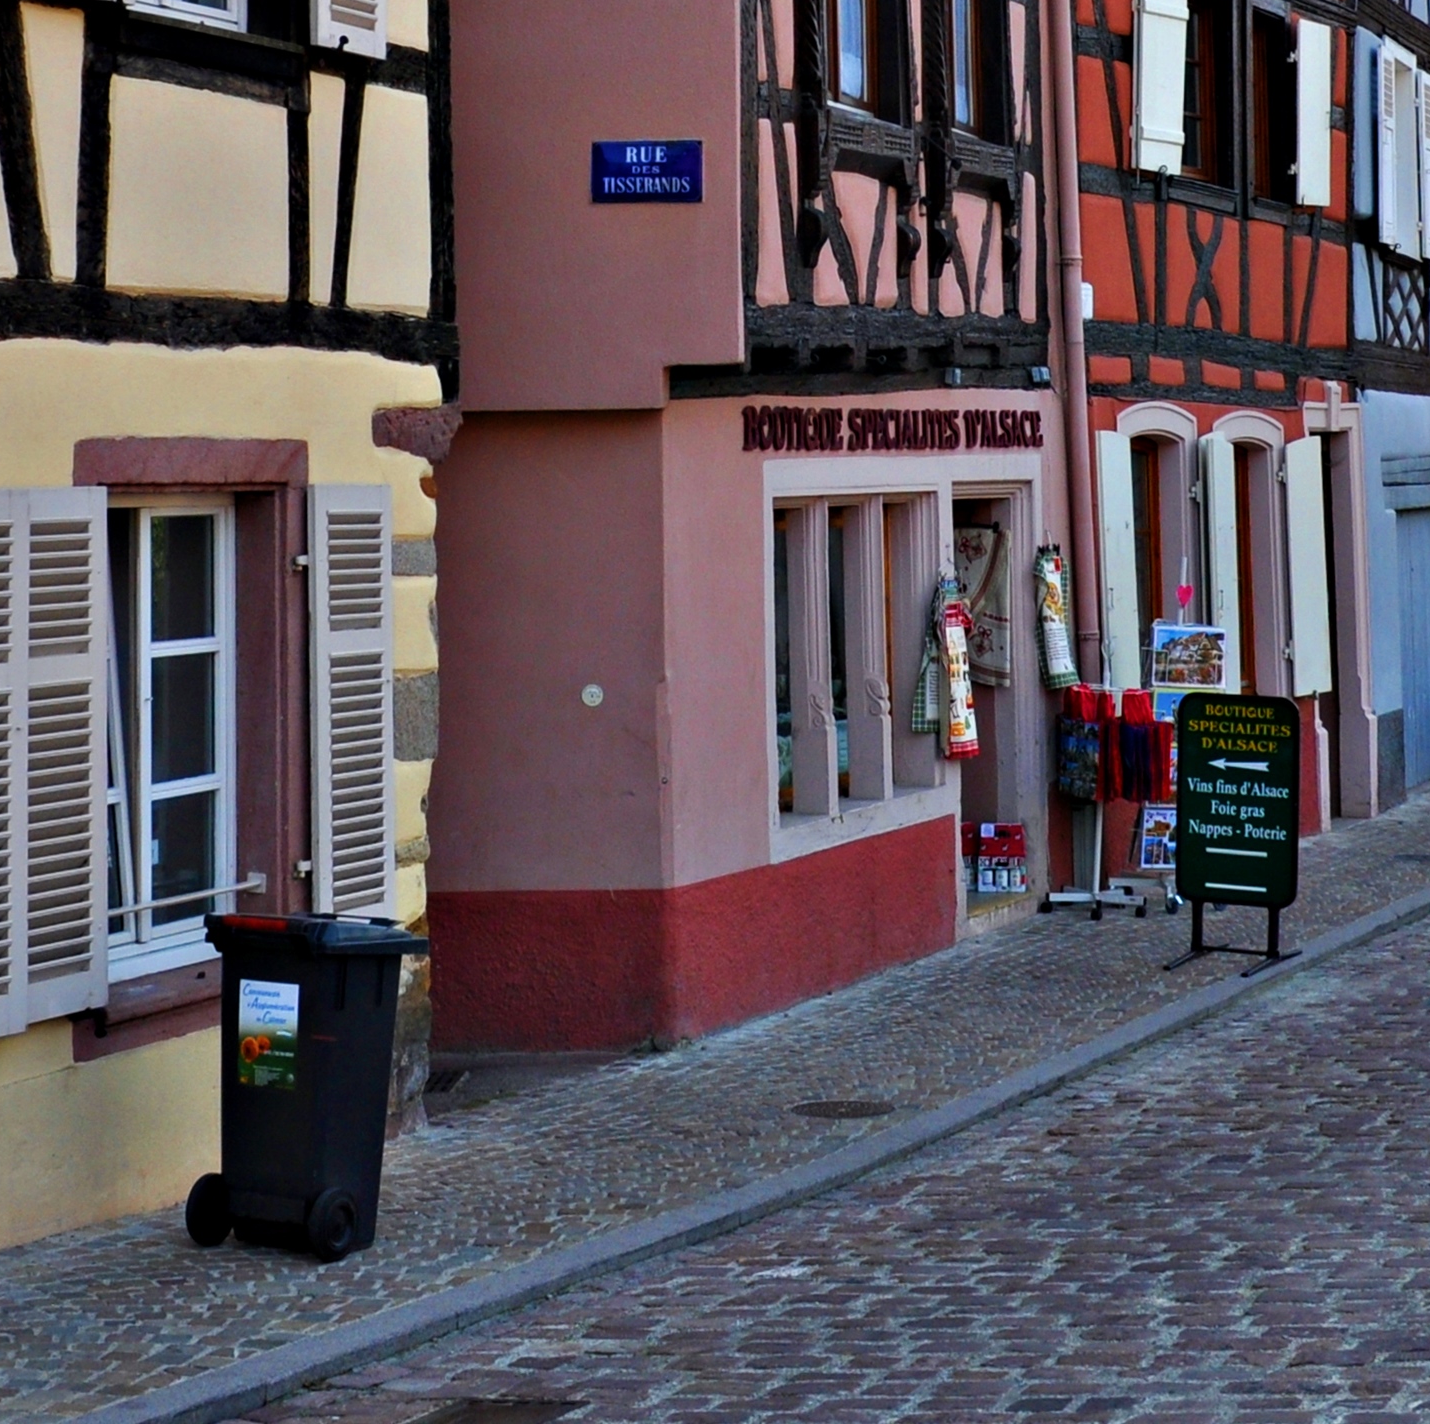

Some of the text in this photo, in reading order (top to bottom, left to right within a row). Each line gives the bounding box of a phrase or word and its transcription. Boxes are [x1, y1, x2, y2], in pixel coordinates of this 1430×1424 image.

[625, 146, 667, 163] RUE
[632, 165, 661, 174] DES
[603, 177, 691, 193] TISSERANDS
[742, 405, 844, 451] BOUTIQUE
[963, 408, 1044, 449] D'ALSACE
[1205, 704, 1275, 720] BOUTIQUE
[1188, 719, 1291, 737] SPECIALITES
[1201, 737, 1278, 754] D'ALSACE
[1187, 777, 1289, 799] Vins fins d'Alsace
[1210, 800, 1265, 821] Foie gras
[1188, 819, 1233, 838] Nappes
[1244, 823, 1287, 841] Poterie
